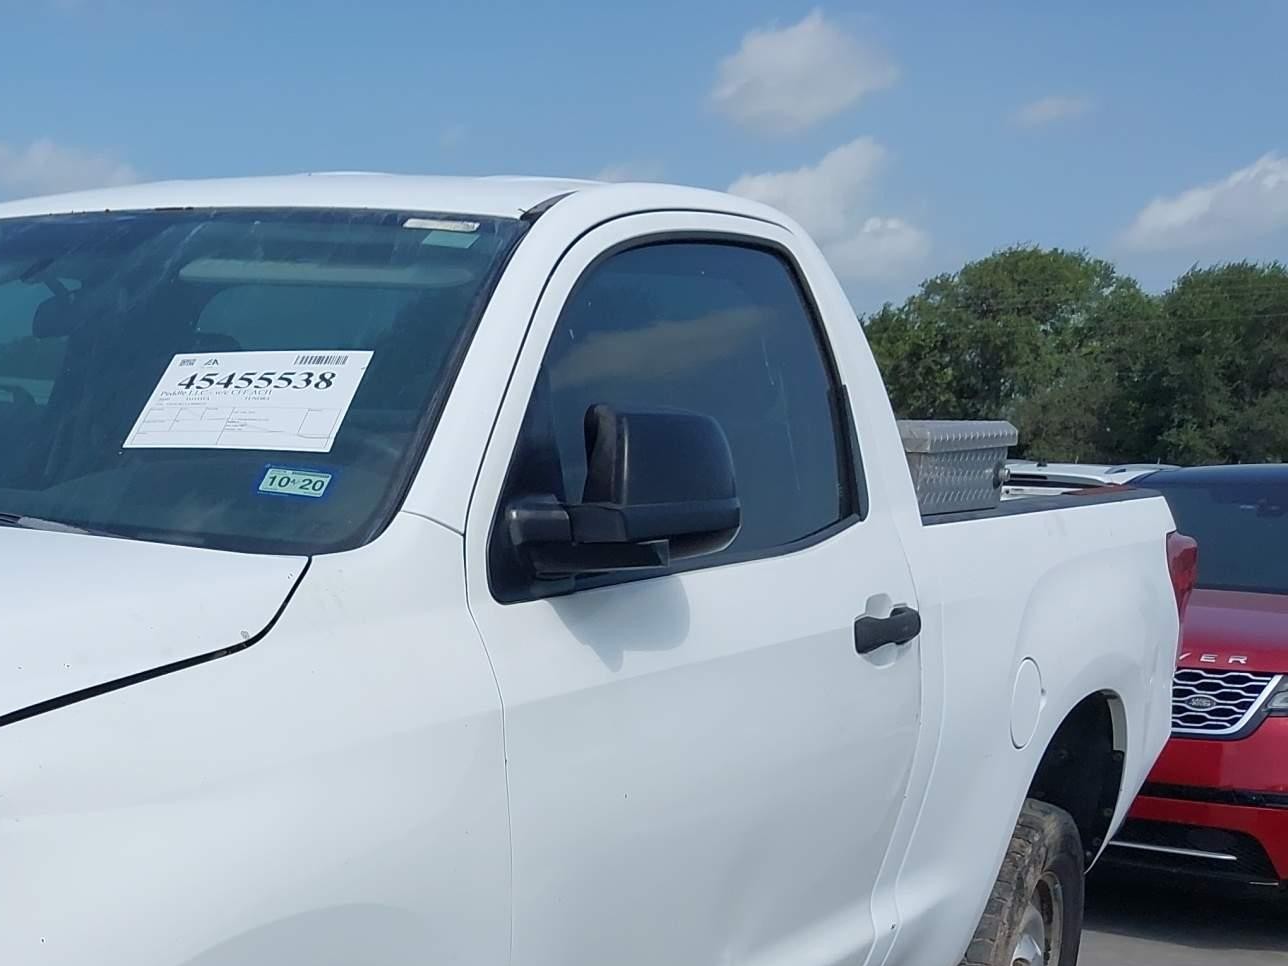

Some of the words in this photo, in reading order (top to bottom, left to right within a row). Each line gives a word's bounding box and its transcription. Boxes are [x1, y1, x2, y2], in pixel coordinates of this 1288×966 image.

[177, 371, 337, 390] 45455538
[269, 474, 291, 488] 10
[299, 478, 325, 492] 20
